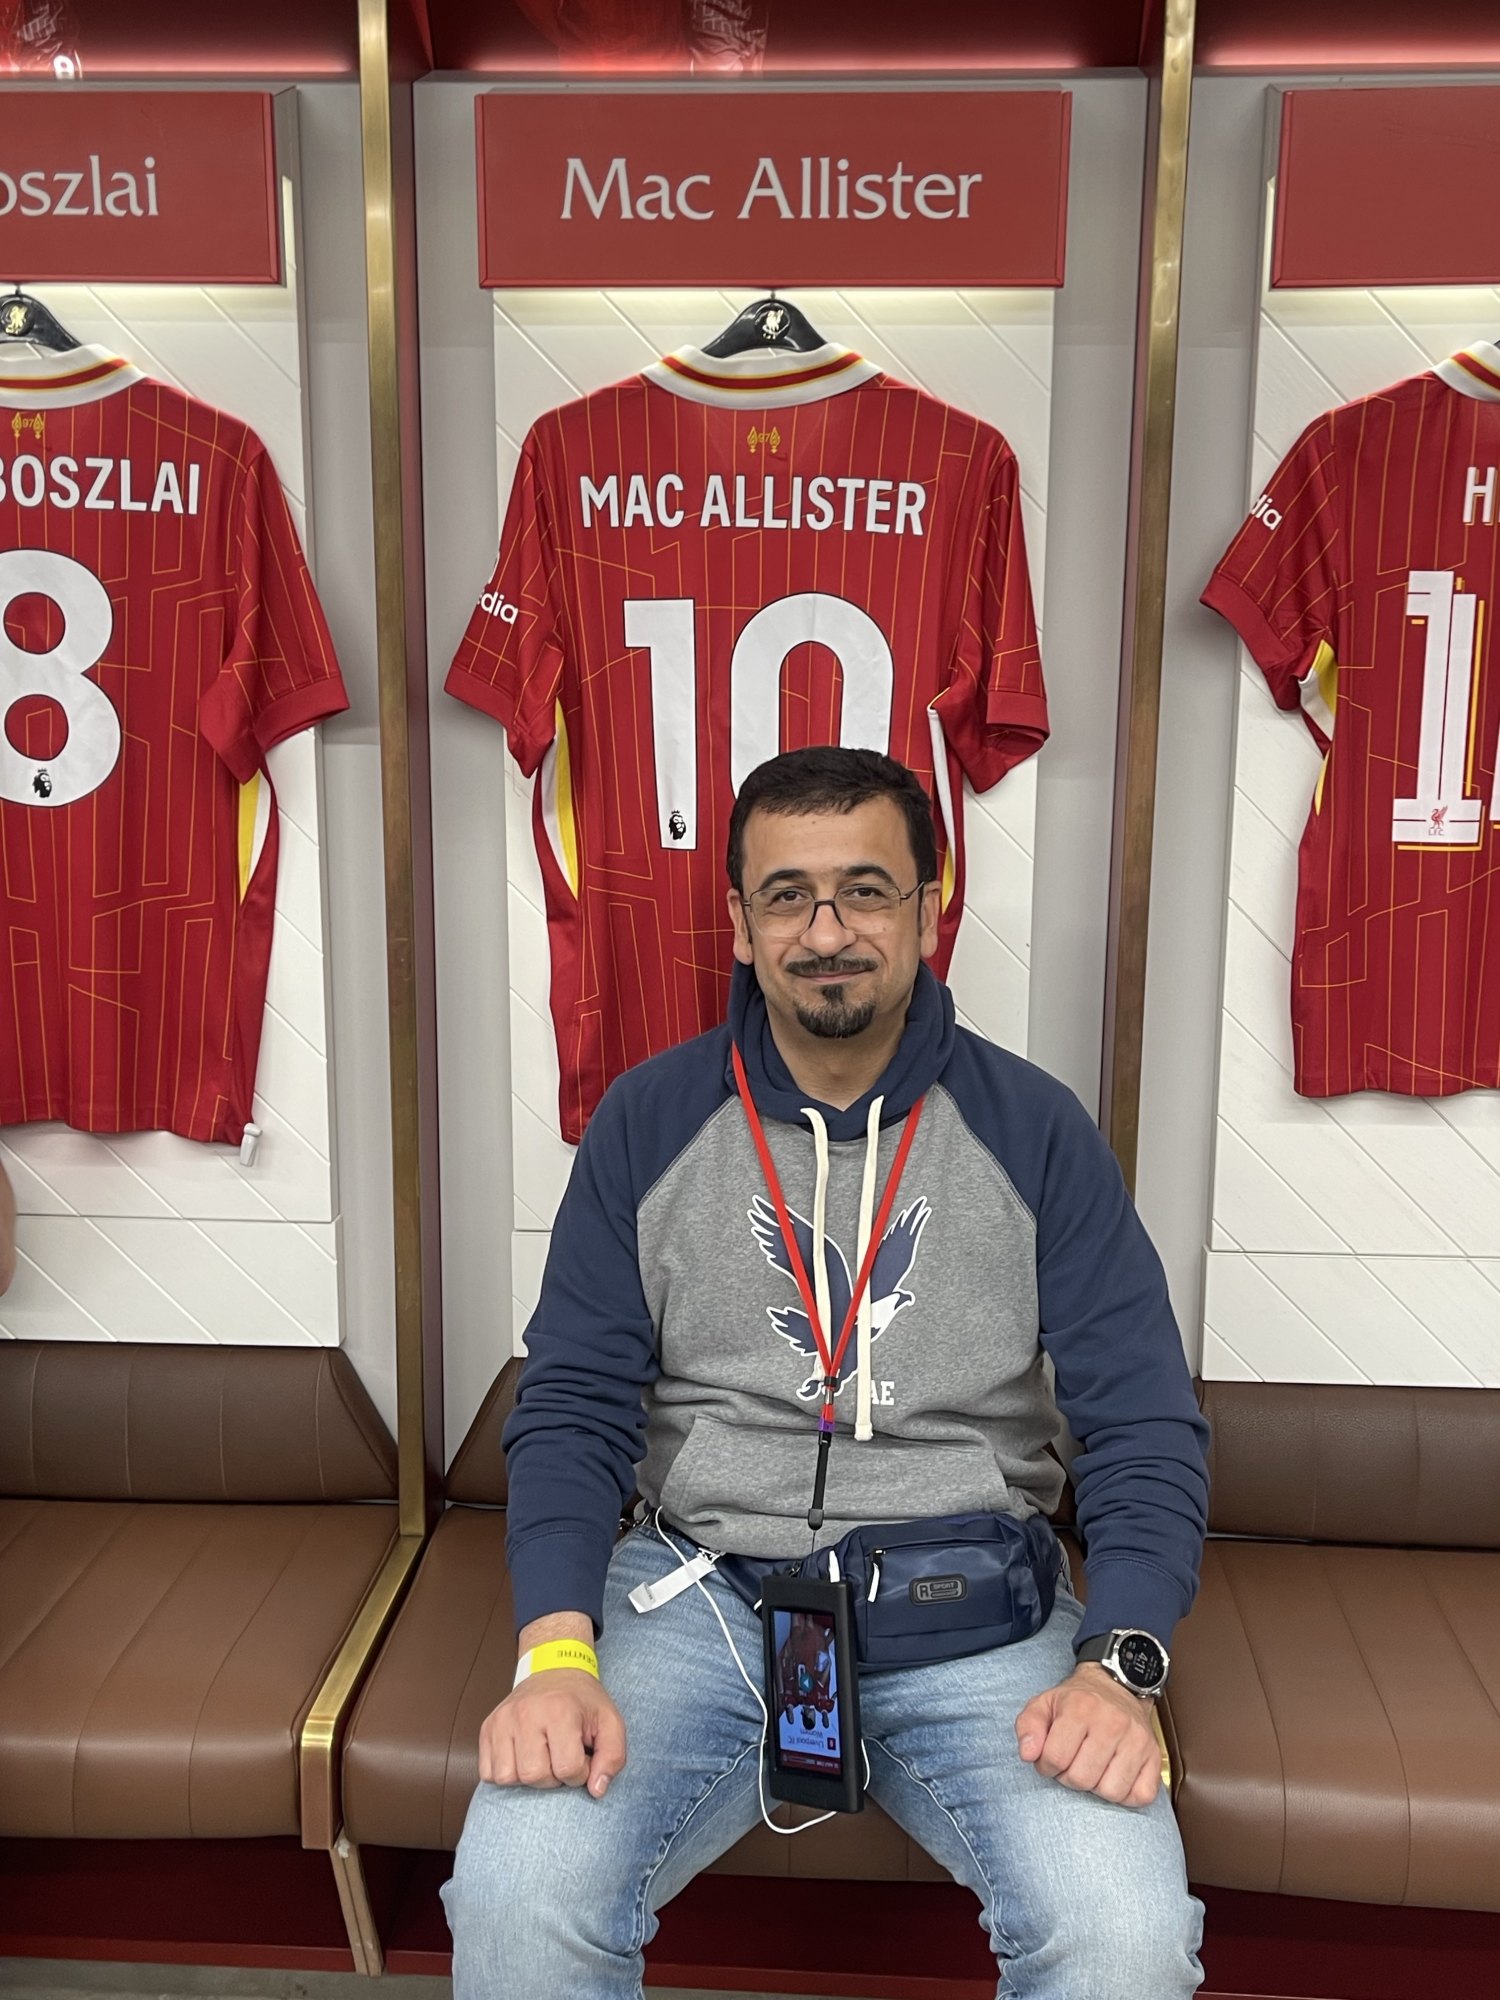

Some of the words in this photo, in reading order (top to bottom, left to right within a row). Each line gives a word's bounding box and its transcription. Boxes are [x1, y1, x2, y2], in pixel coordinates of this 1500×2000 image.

[560, 157, 715, 220] Mac
[736, 156, 983, 219] Allister
[0, 454, 200, 515] OSZLAI
[579, 473, 685, 529] MAC
[699, 474, 926, 537] ALLISTER
[1462, 466, 1500, 526] H
[478, 591, 519, 625] dia
[0, 548, 121, 807] 8
[1391, 571, 1500, 844] 1
[623, 592, 894, 850] 10
